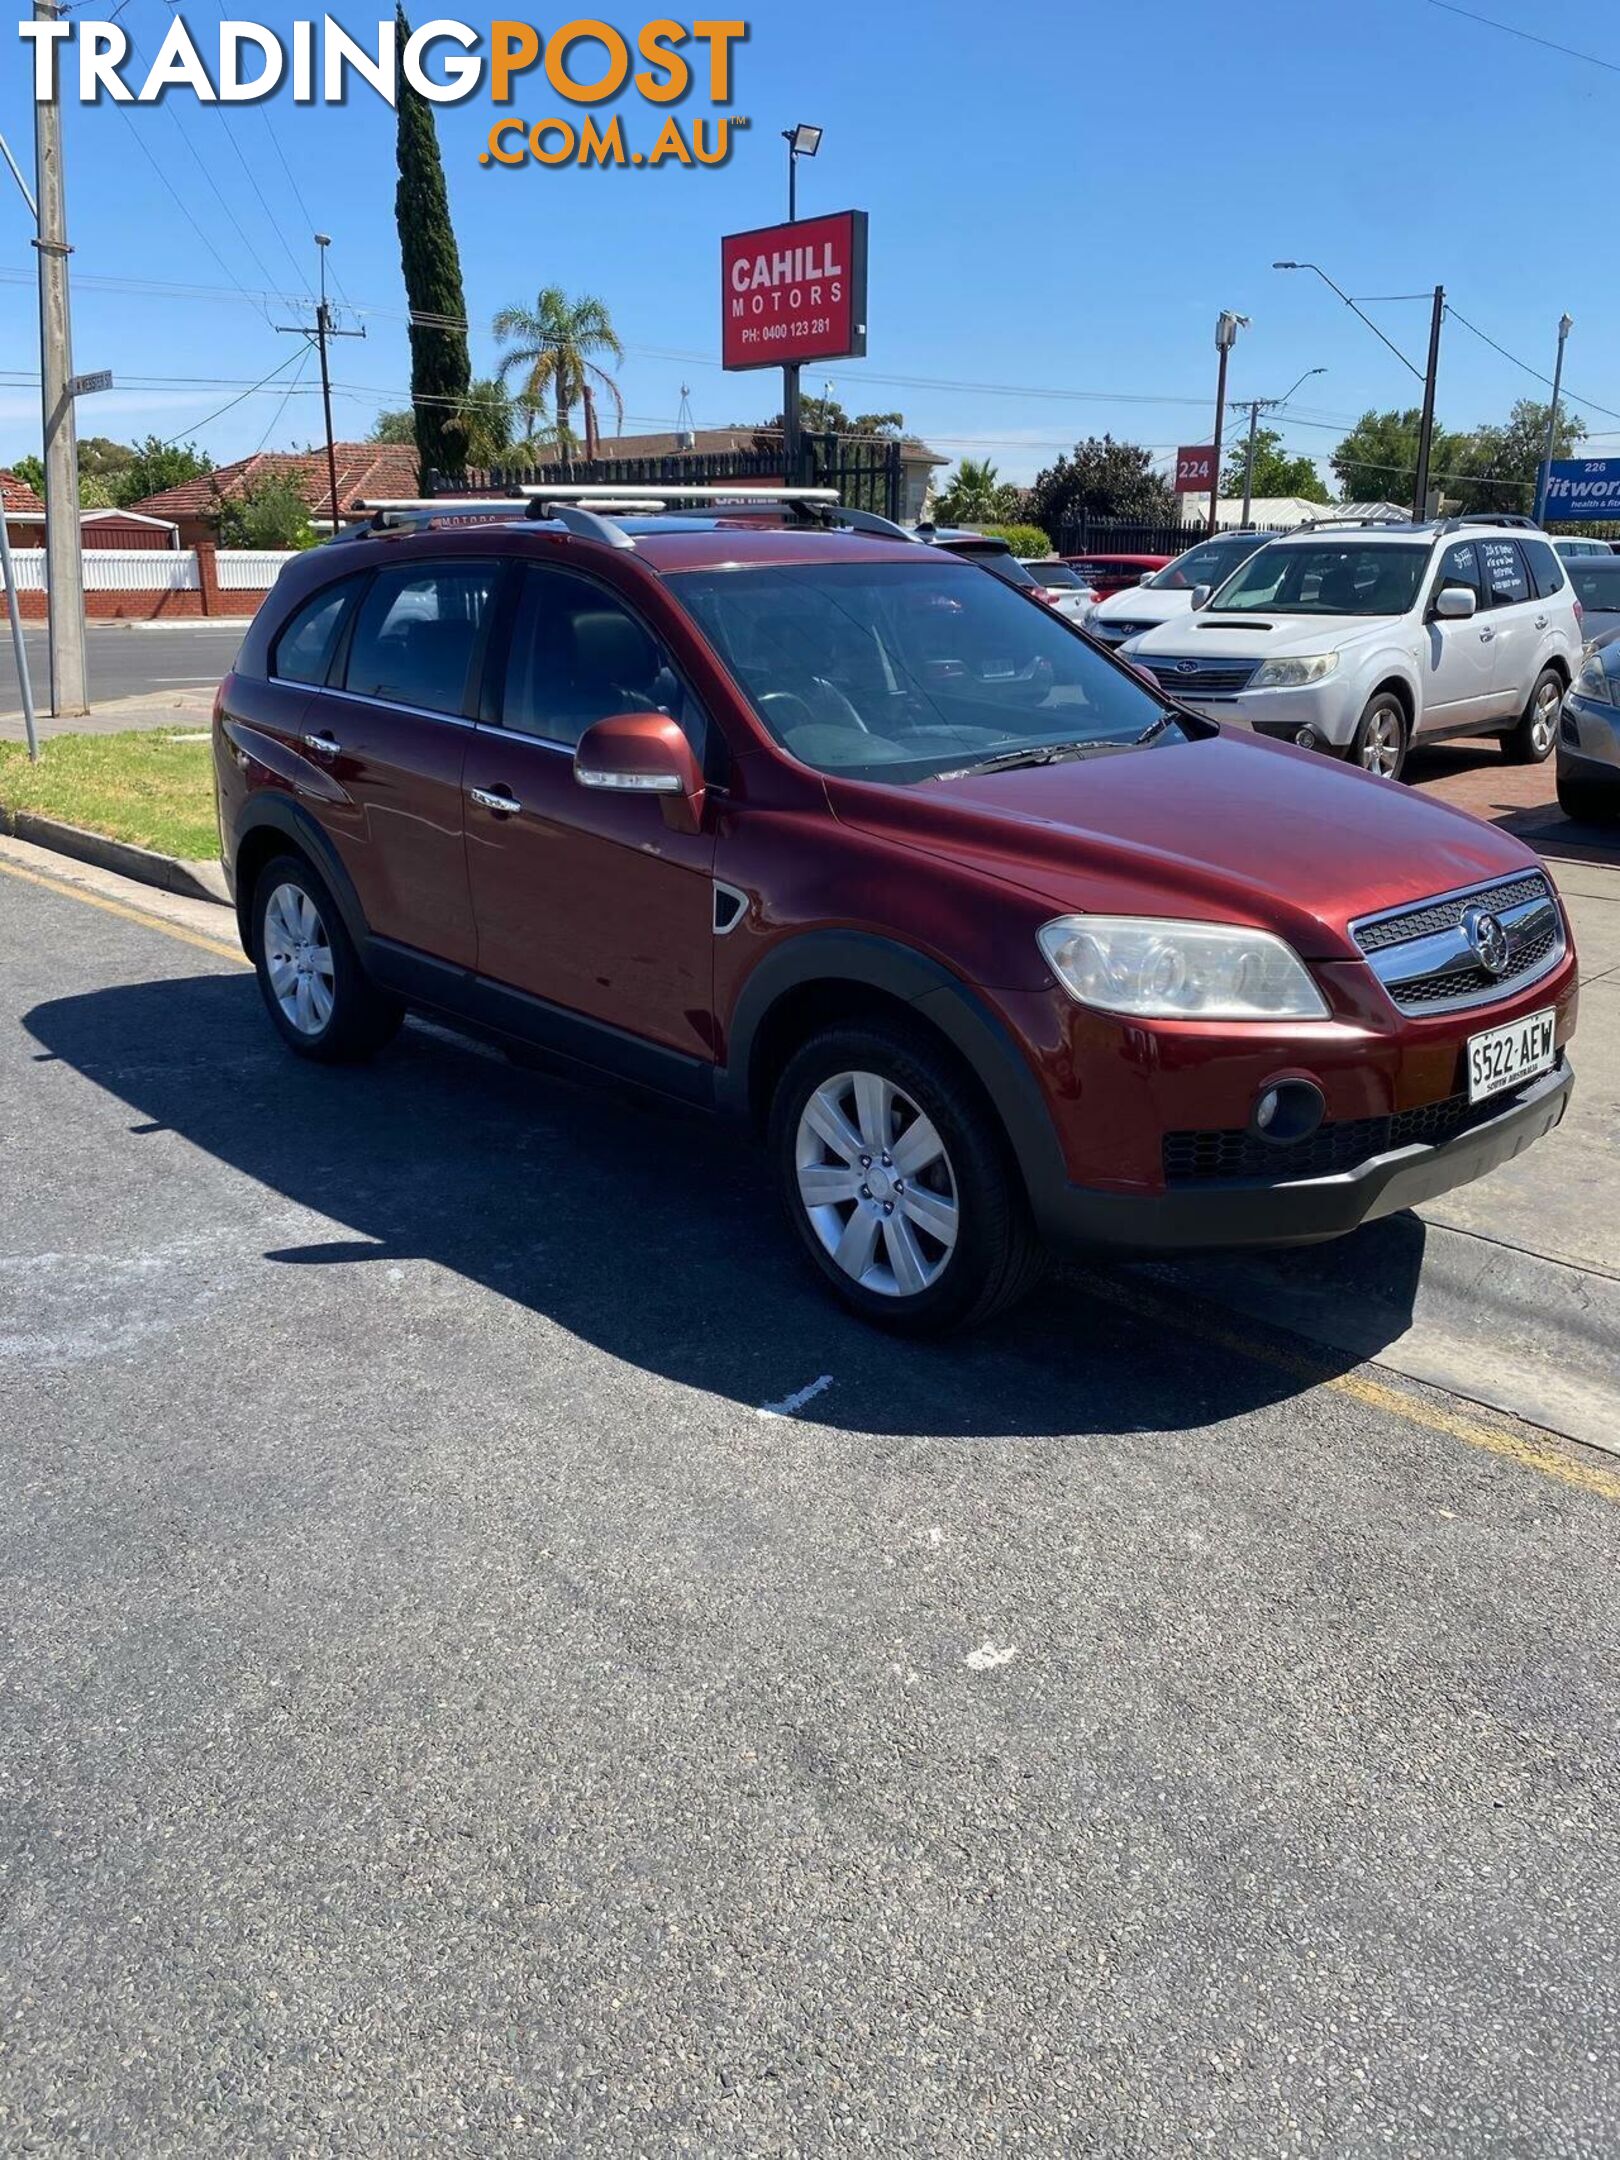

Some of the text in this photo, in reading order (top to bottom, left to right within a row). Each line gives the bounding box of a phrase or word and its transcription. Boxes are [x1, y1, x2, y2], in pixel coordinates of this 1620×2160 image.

[731, 242, 842, 292] CAHILL
[732, 281, 842, 317] MOTORS
[742, 317, 830, 343] PH: 0400 123 281
[1179, 460, 1209, 478] 224
[1584, 462, 1606, 472] 226
[1571, 501, 1599, 509] health
[1486, 1063, 1539, 1093] SOUTH AUSTRALIA
